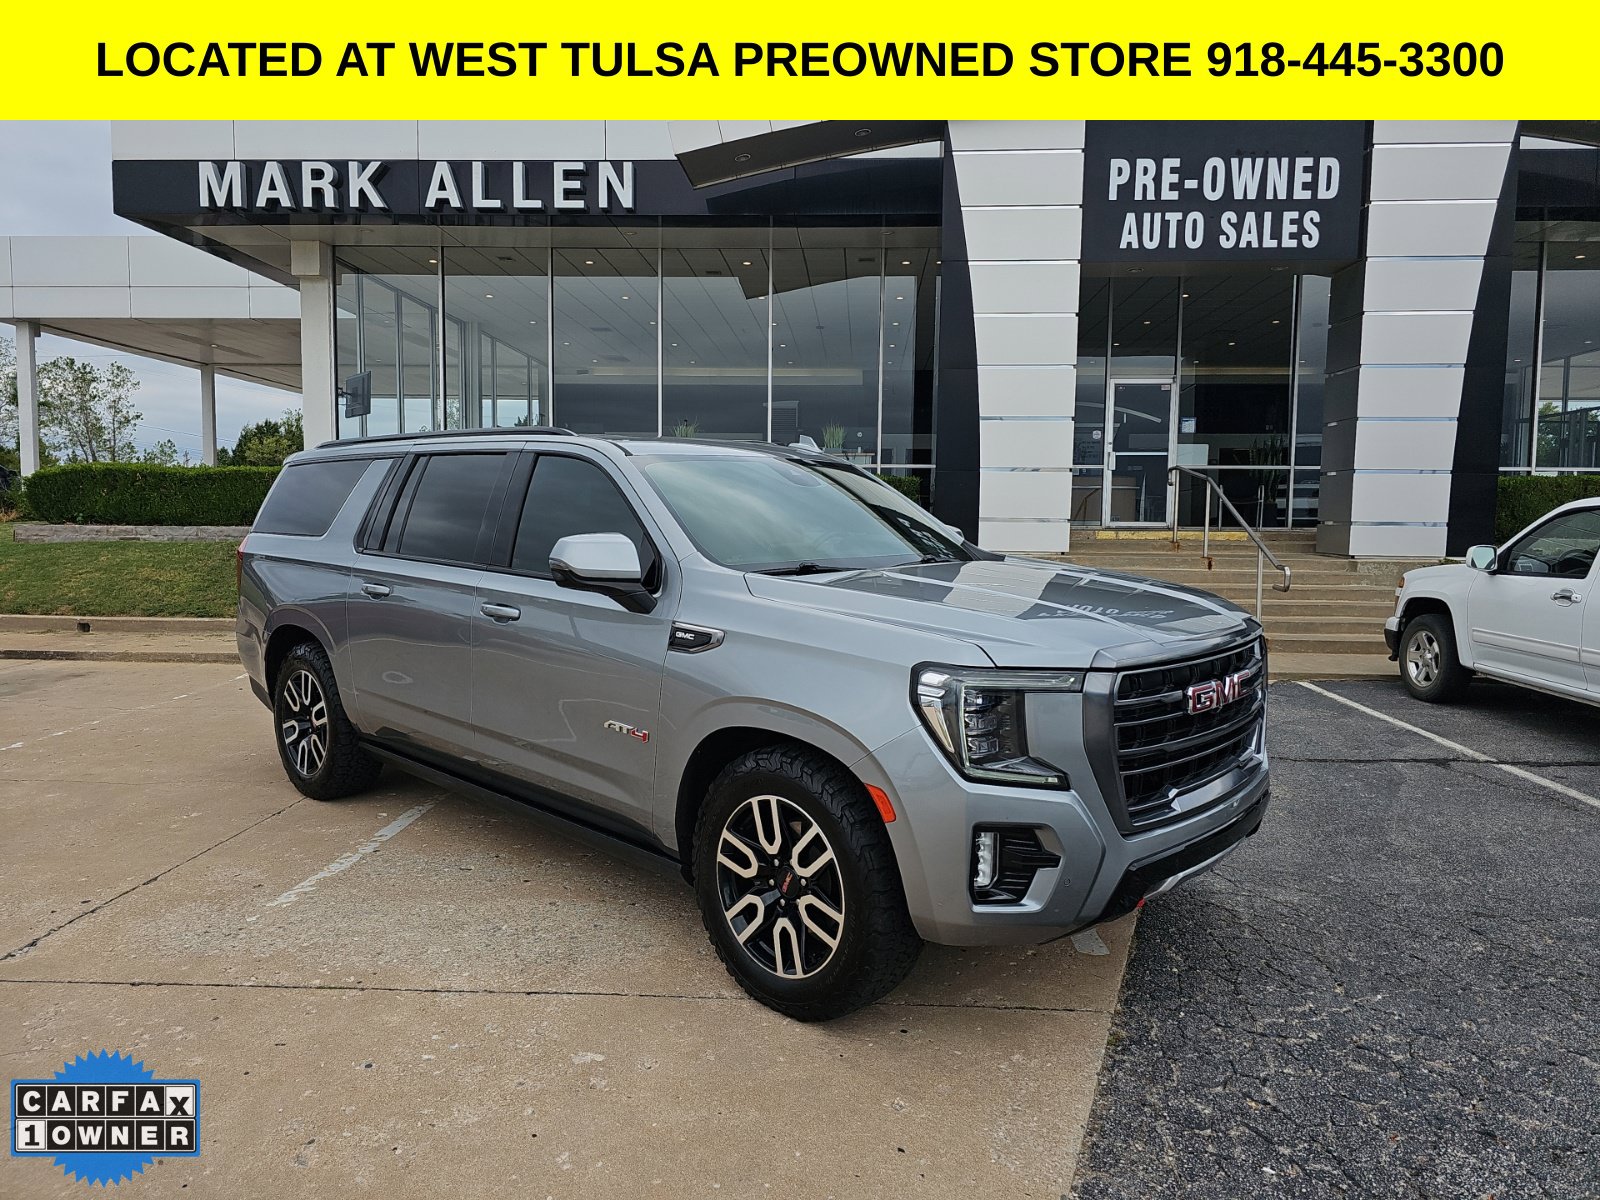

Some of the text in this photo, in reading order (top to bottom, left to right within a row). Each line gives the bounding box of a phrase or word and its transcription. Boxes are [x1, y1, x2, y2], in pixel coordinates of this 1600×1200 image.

[197, 160, 637, 211] MARK ALLEN
[1108, 156, 1341, 201] PRE-OWNED
[1118, 209, 1321, 250] AUTO SALES
[675, 631, 695, 640] GMC
[1186, 669, 1251, 715] GMC
[603, 719, 650, 743] AT4
